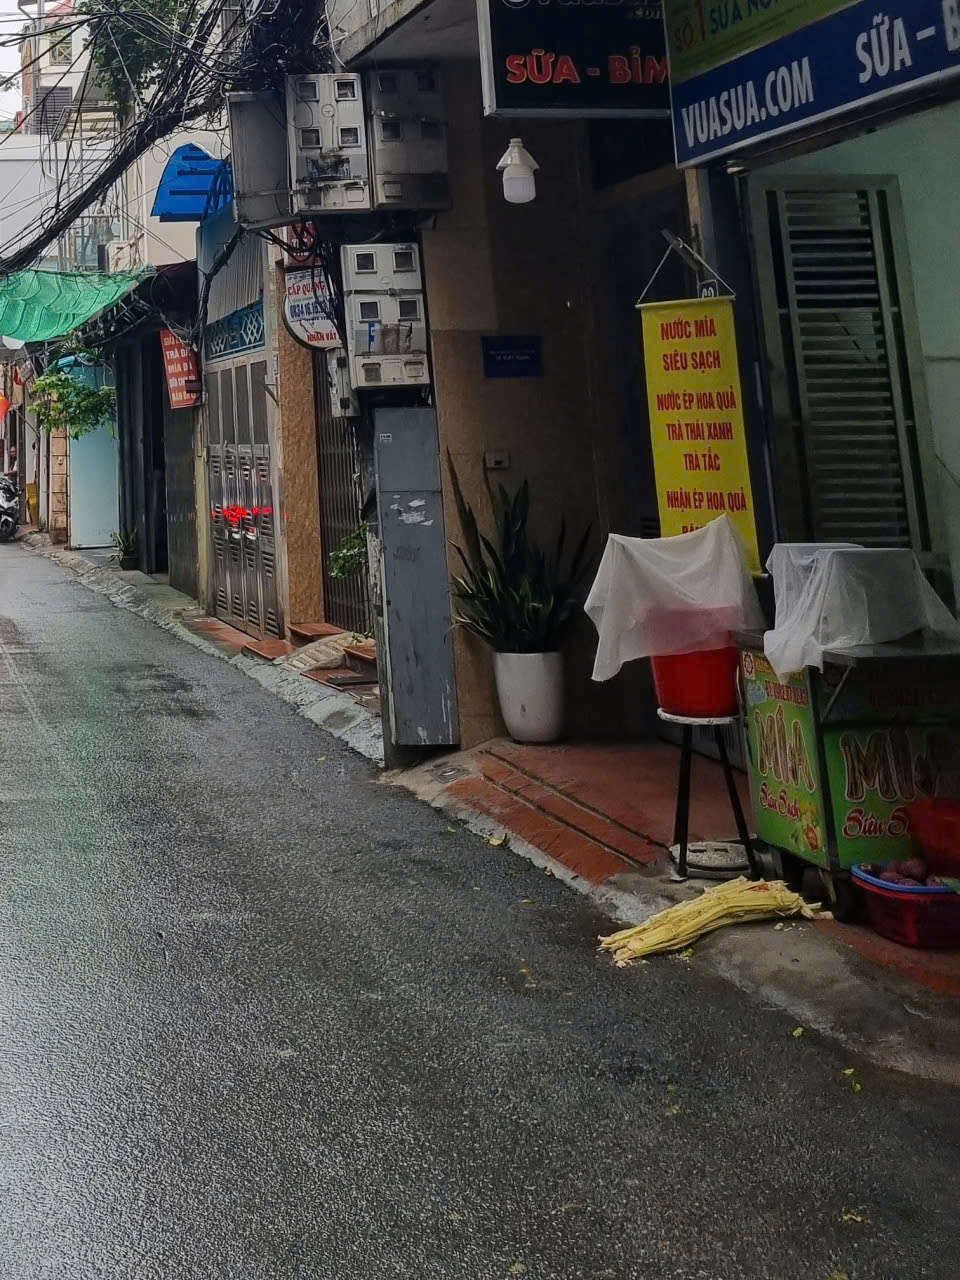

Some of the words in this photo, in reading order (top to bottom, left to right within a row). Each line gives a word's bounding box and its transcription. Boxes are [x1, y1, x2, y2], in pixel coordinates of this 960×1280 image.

[505, 48, 582, 84] SỮA
[681, 56, 815, 148] VUASUA.COM
[855, 12, 913, 84] SỮA
[660, 318, 692, 340] NƯỚC
[166, 348, 180, 359] TRÀ
[662, 349, 688, 371] SIÊU
[691, 350, 721, 373] SẠCH
[656, 389, 681, 410] NƯỚC
[682, 389, 694, 410] ÉP
[696, 391, 715, 410] HOA
[717, 384, 737, 411] QUẢ
[666, 419, 683, 440] TRÀ
[684, 419, 704, 440] THÁI
[706, 422, 733, 440] XANH
[683, 449, 700, 471] TRÀ
[666, 487, 691, 512] NHẬN
[693, 488, 704, 509] ÉP
[706, 491, 726, 510] HOA
[727, 486, 747, 512] QUẢ
